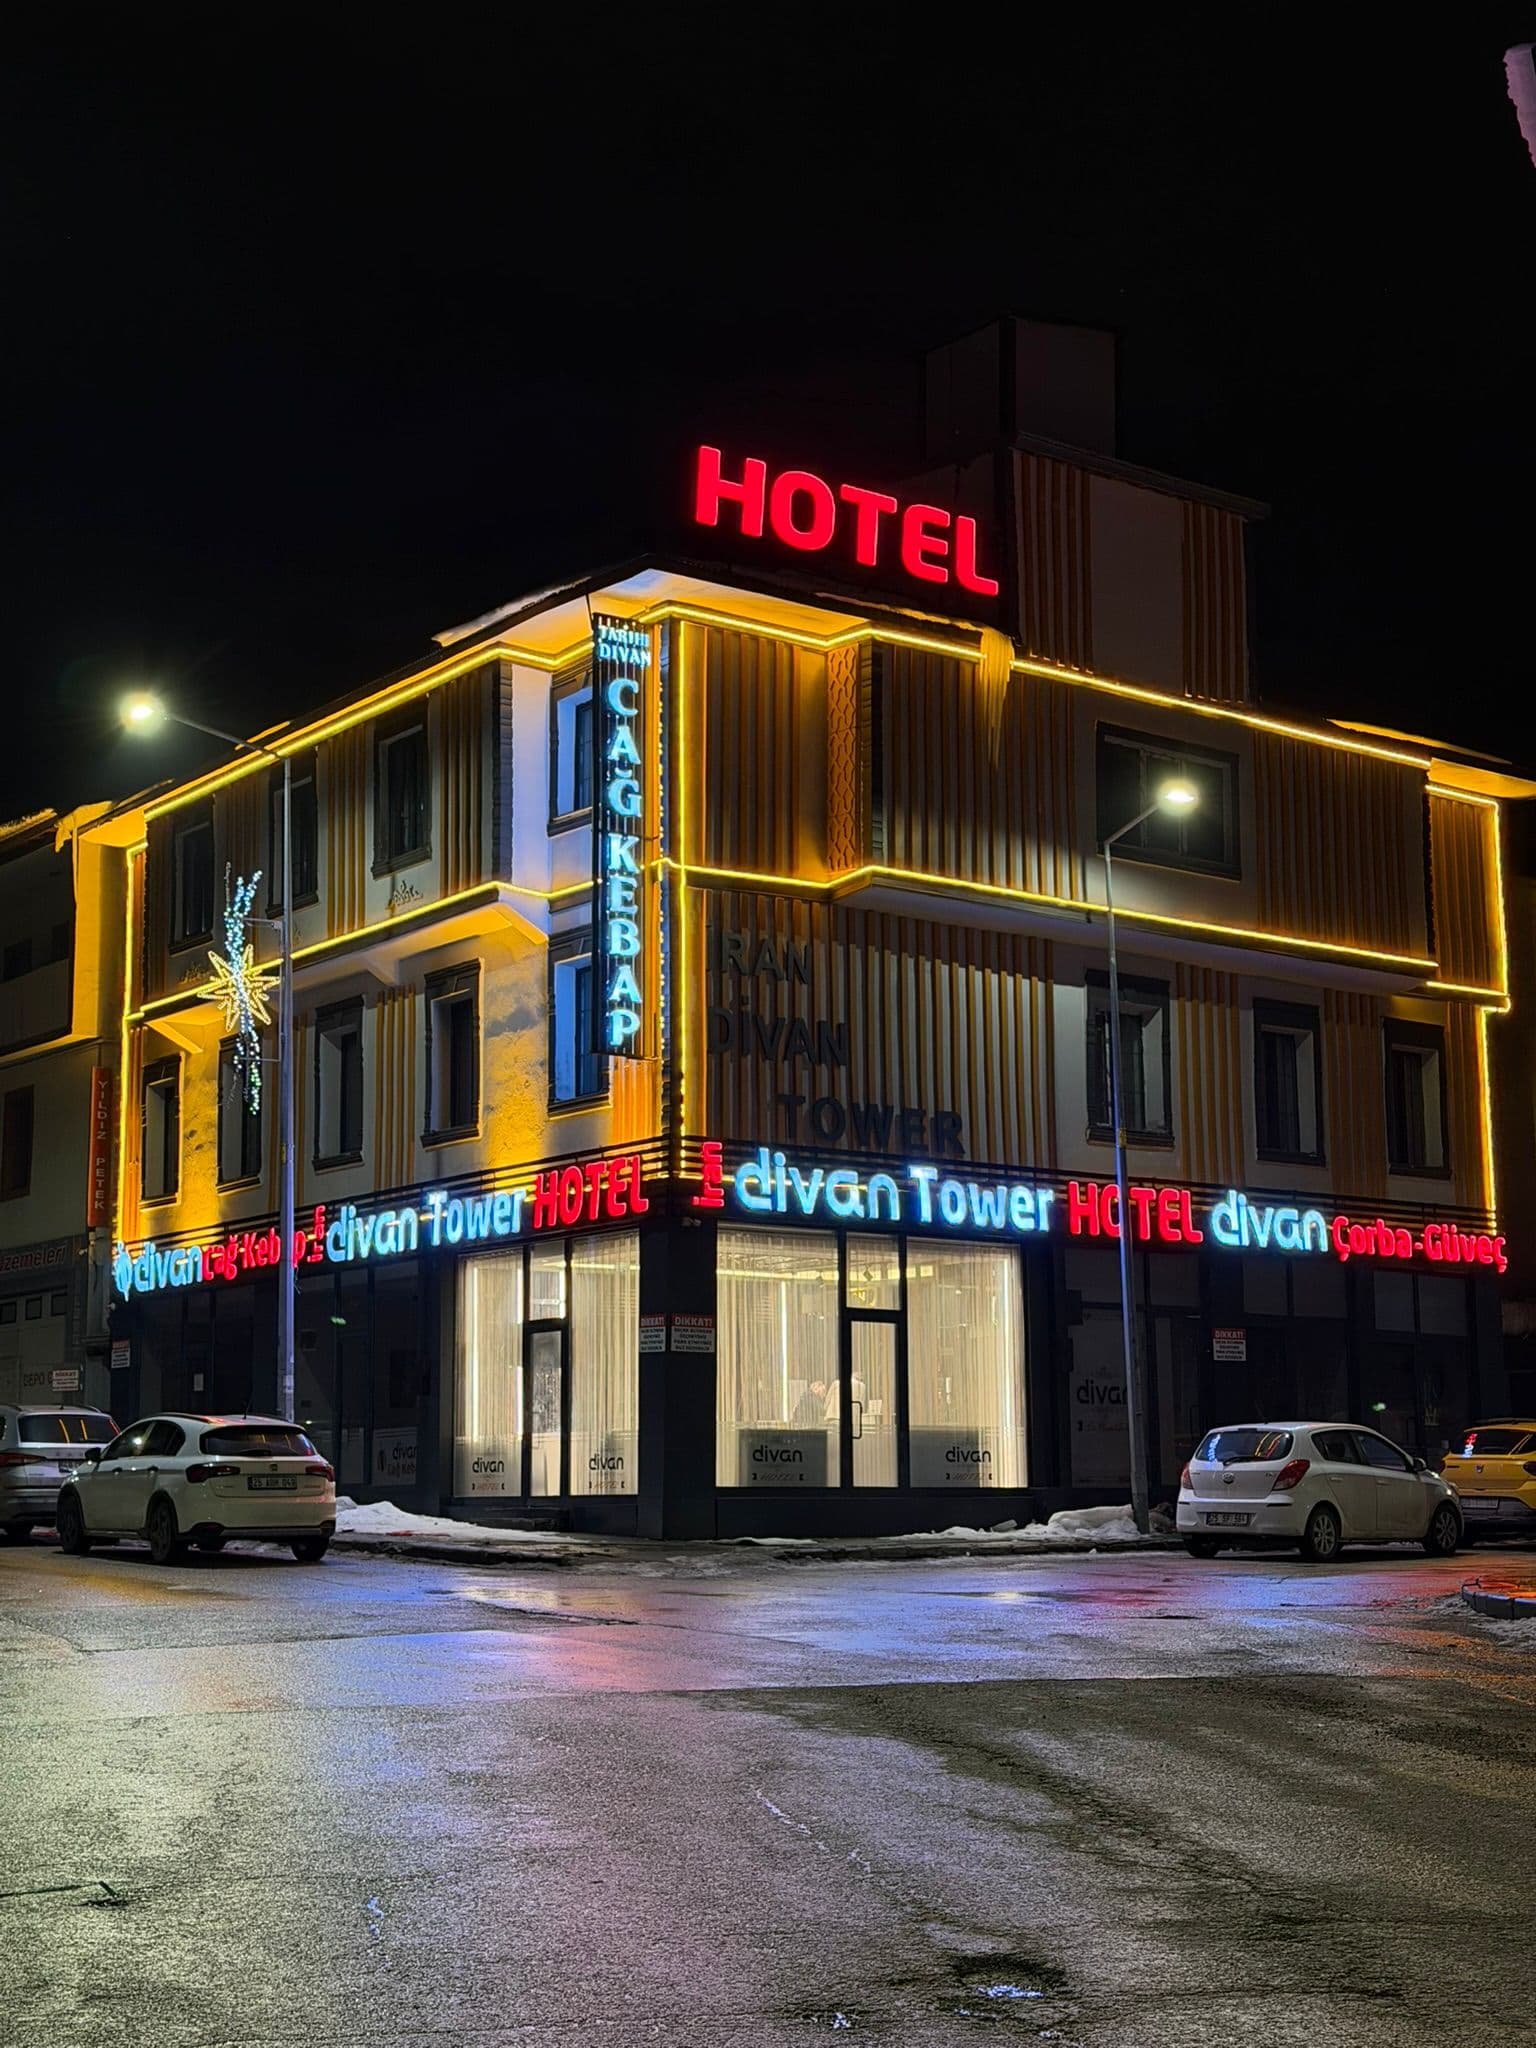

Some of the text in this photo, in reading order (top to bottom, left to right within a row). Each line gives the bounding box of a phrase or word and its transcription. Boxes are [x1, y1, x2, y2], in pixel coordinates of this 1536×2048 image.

[695, 445, 999, 597] HOTEL
[607, 678, 643, 1046] CAĞ KEBAP
[775, 1094, 965, 1154] TOWER
[95, 1157, 106, 1209] PETEK
[326, 1154, 650, 1263] divan Tower HOTEL
[734, 1147, 1204, 1243] divan Tower HOTEL
[1211, 1189, 1329, 1252] divan
[0, 1246, 67, 1273] zemeleri
[134, 1241, 203, 1292] divan
[243, 1227, 306, 1269] Kebp
[472, 1457, 505, 1473] divan
[588, 1453, 624, 1471] divan
[752, 1445, 803, 1463] divan
[945, 1446, 992, 1463] divan
